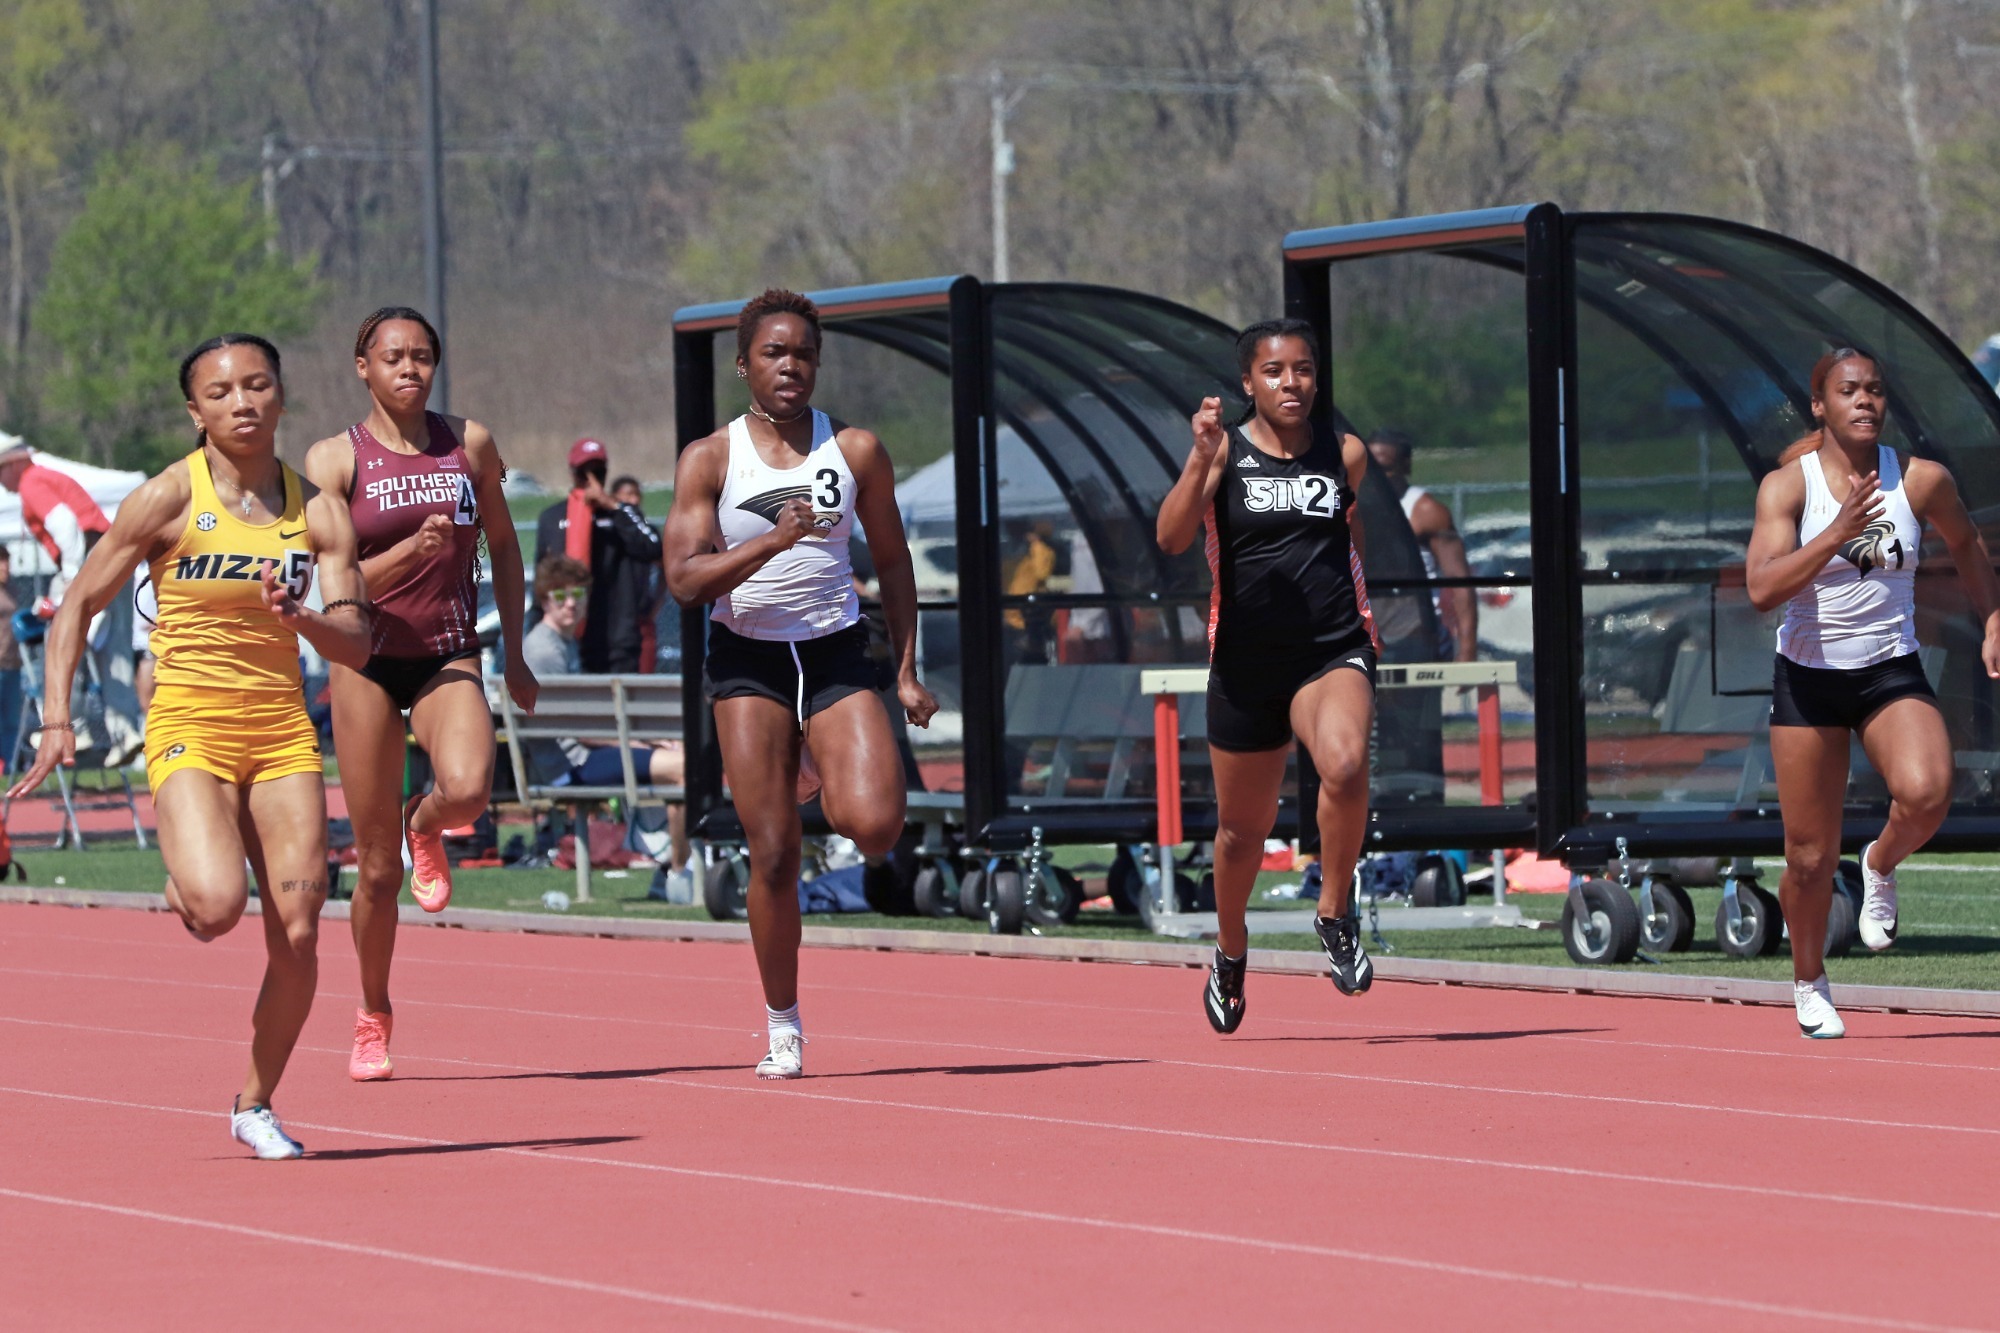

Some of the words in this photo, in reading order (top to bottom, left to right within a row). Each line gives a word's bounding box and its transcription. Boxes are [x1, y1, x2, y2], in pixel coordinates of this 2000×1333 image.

[379, 487, 458, 511] ILLINOIS
[458, 480, 475, 521] 4
[815, 468, 841, 508] 3
[1305, 477, 1328, 514] 2
[197, 512, 216, 530] SEC
[175, 554, 286, 583] MIZZ
[1887, 538, 1904, 570] 1
[287, 553, 310, 600] 5
[1416, 671, 1444, 680] GILL
[281, 880, 298, 892] BY
